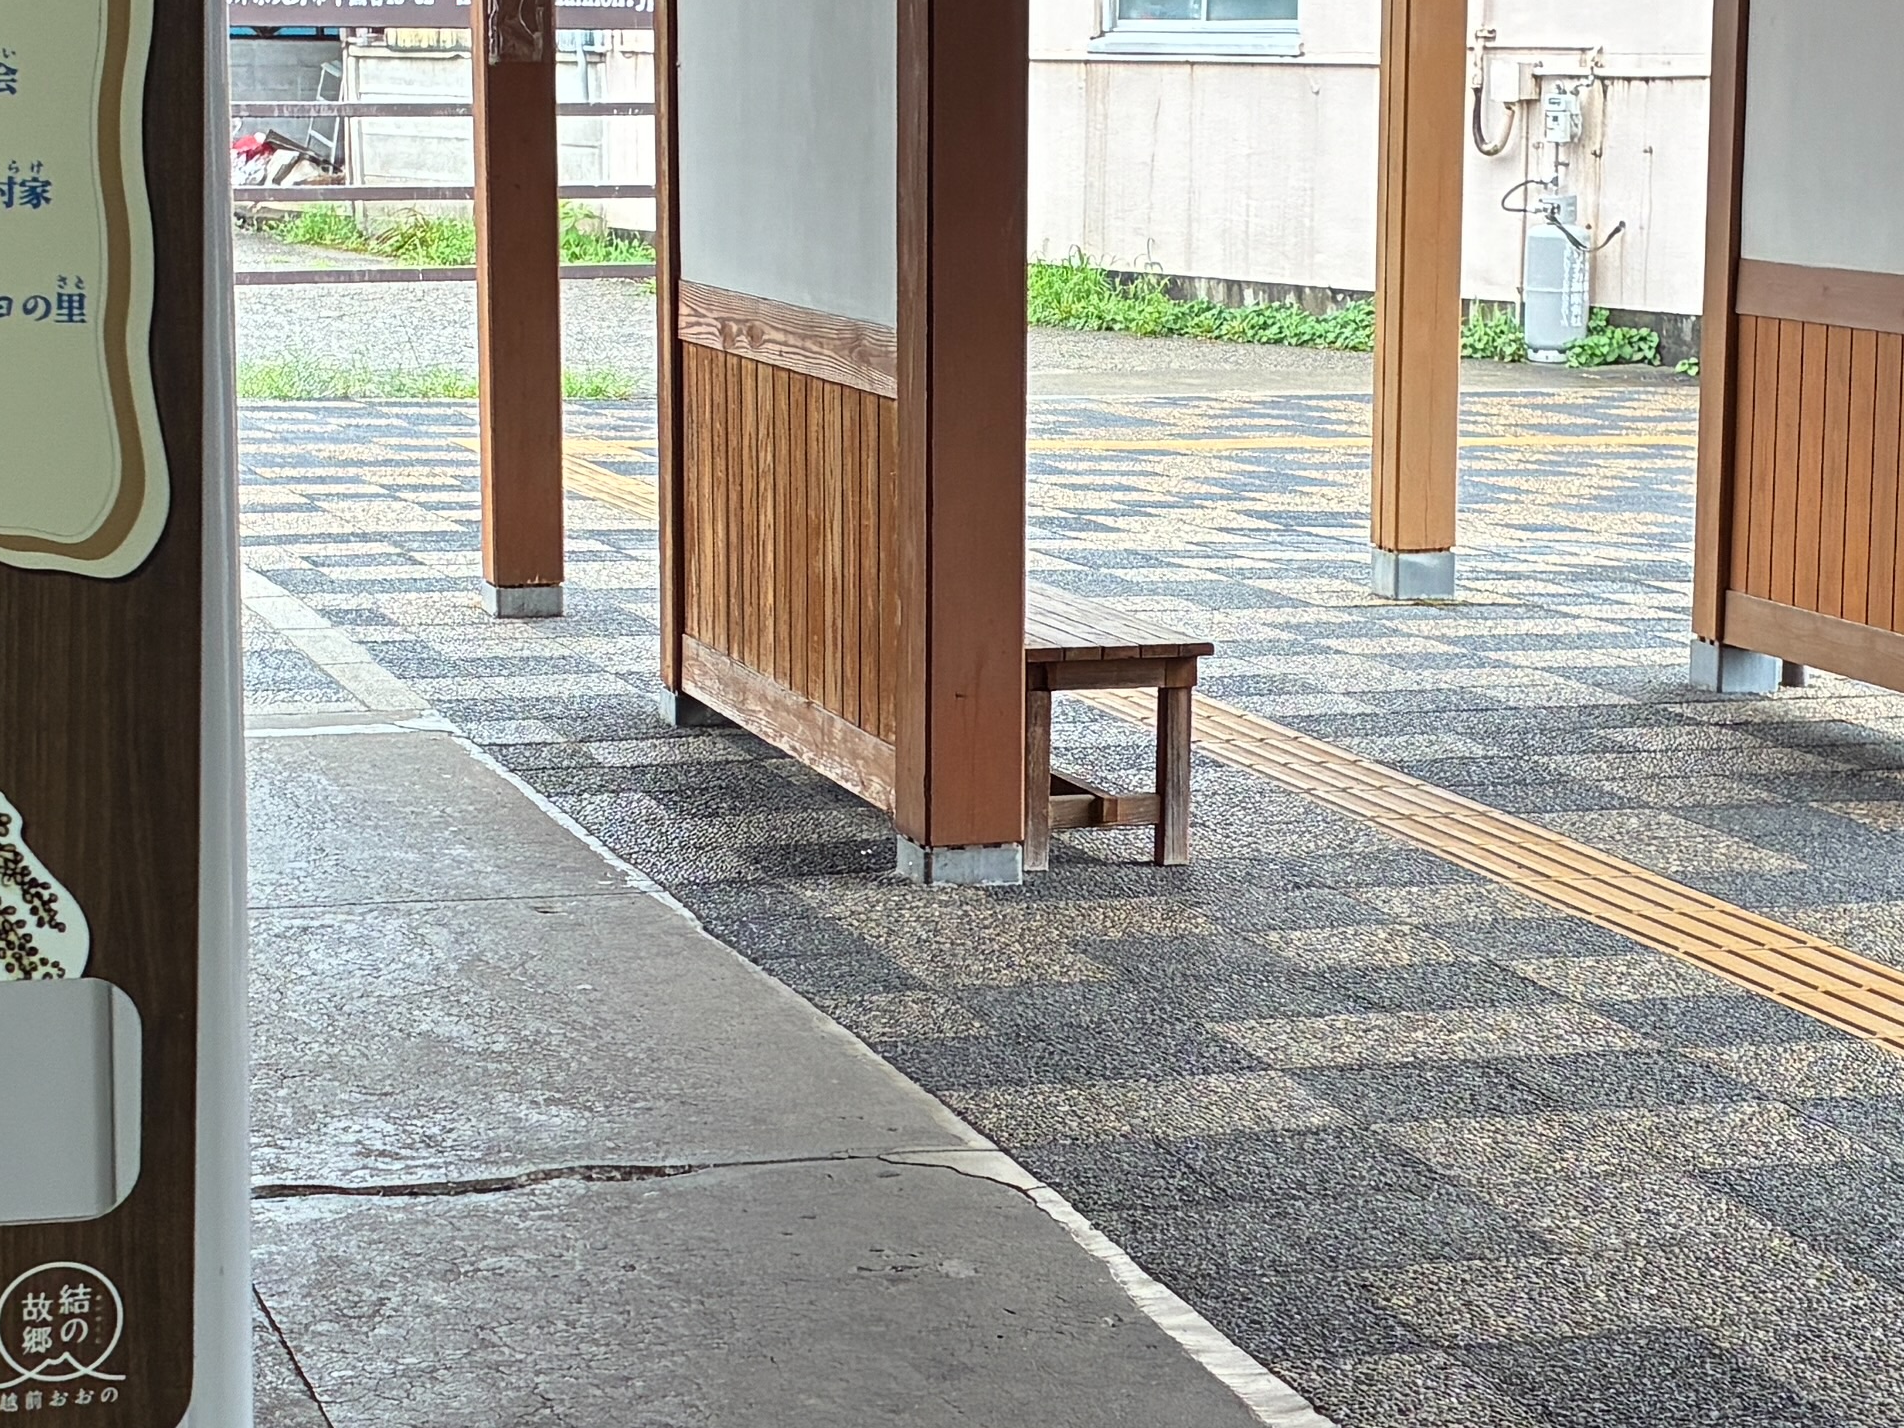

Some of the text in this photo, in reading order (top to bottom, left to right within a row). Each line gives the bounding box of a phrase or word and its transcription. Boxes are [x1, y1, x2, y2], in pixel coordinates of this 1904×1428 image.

[21, 1292, 54, 1356] 故郷
[58, 1283, 92, 1344] 結の
[0, 1386, 120, 1413] 越前おおの
